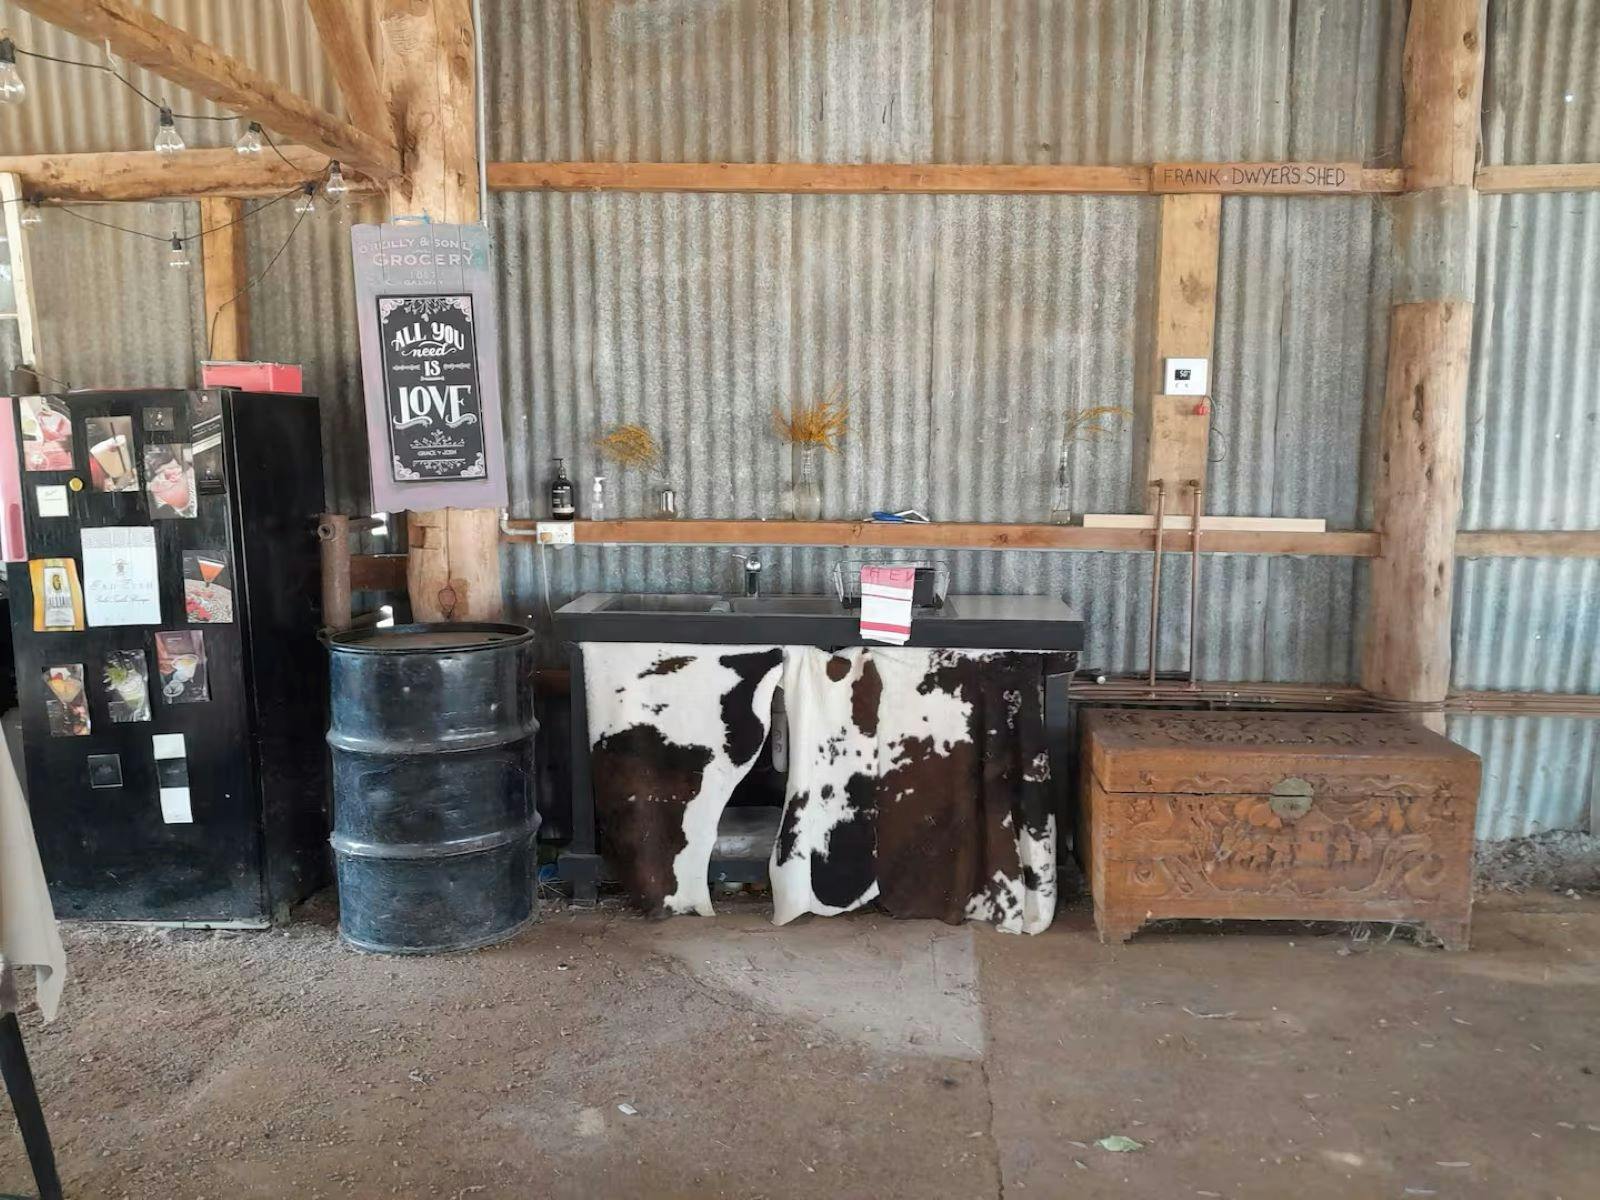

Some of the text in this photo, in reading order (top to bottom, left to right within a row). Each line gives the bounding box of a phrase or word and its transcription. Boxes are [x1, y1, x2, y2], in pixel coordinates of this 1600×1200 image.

[1164, 167, 1221, 186] FRANK
[1304, 166, 1345, 186] SHED
[373, 253, 474, 266] GROCERY
[391, 321, 464, 351] ALL YOU
[401, 342, 457, 357] need
[424, 360, 441, 376] IS
[394, 384, 478, 429] LOVE
